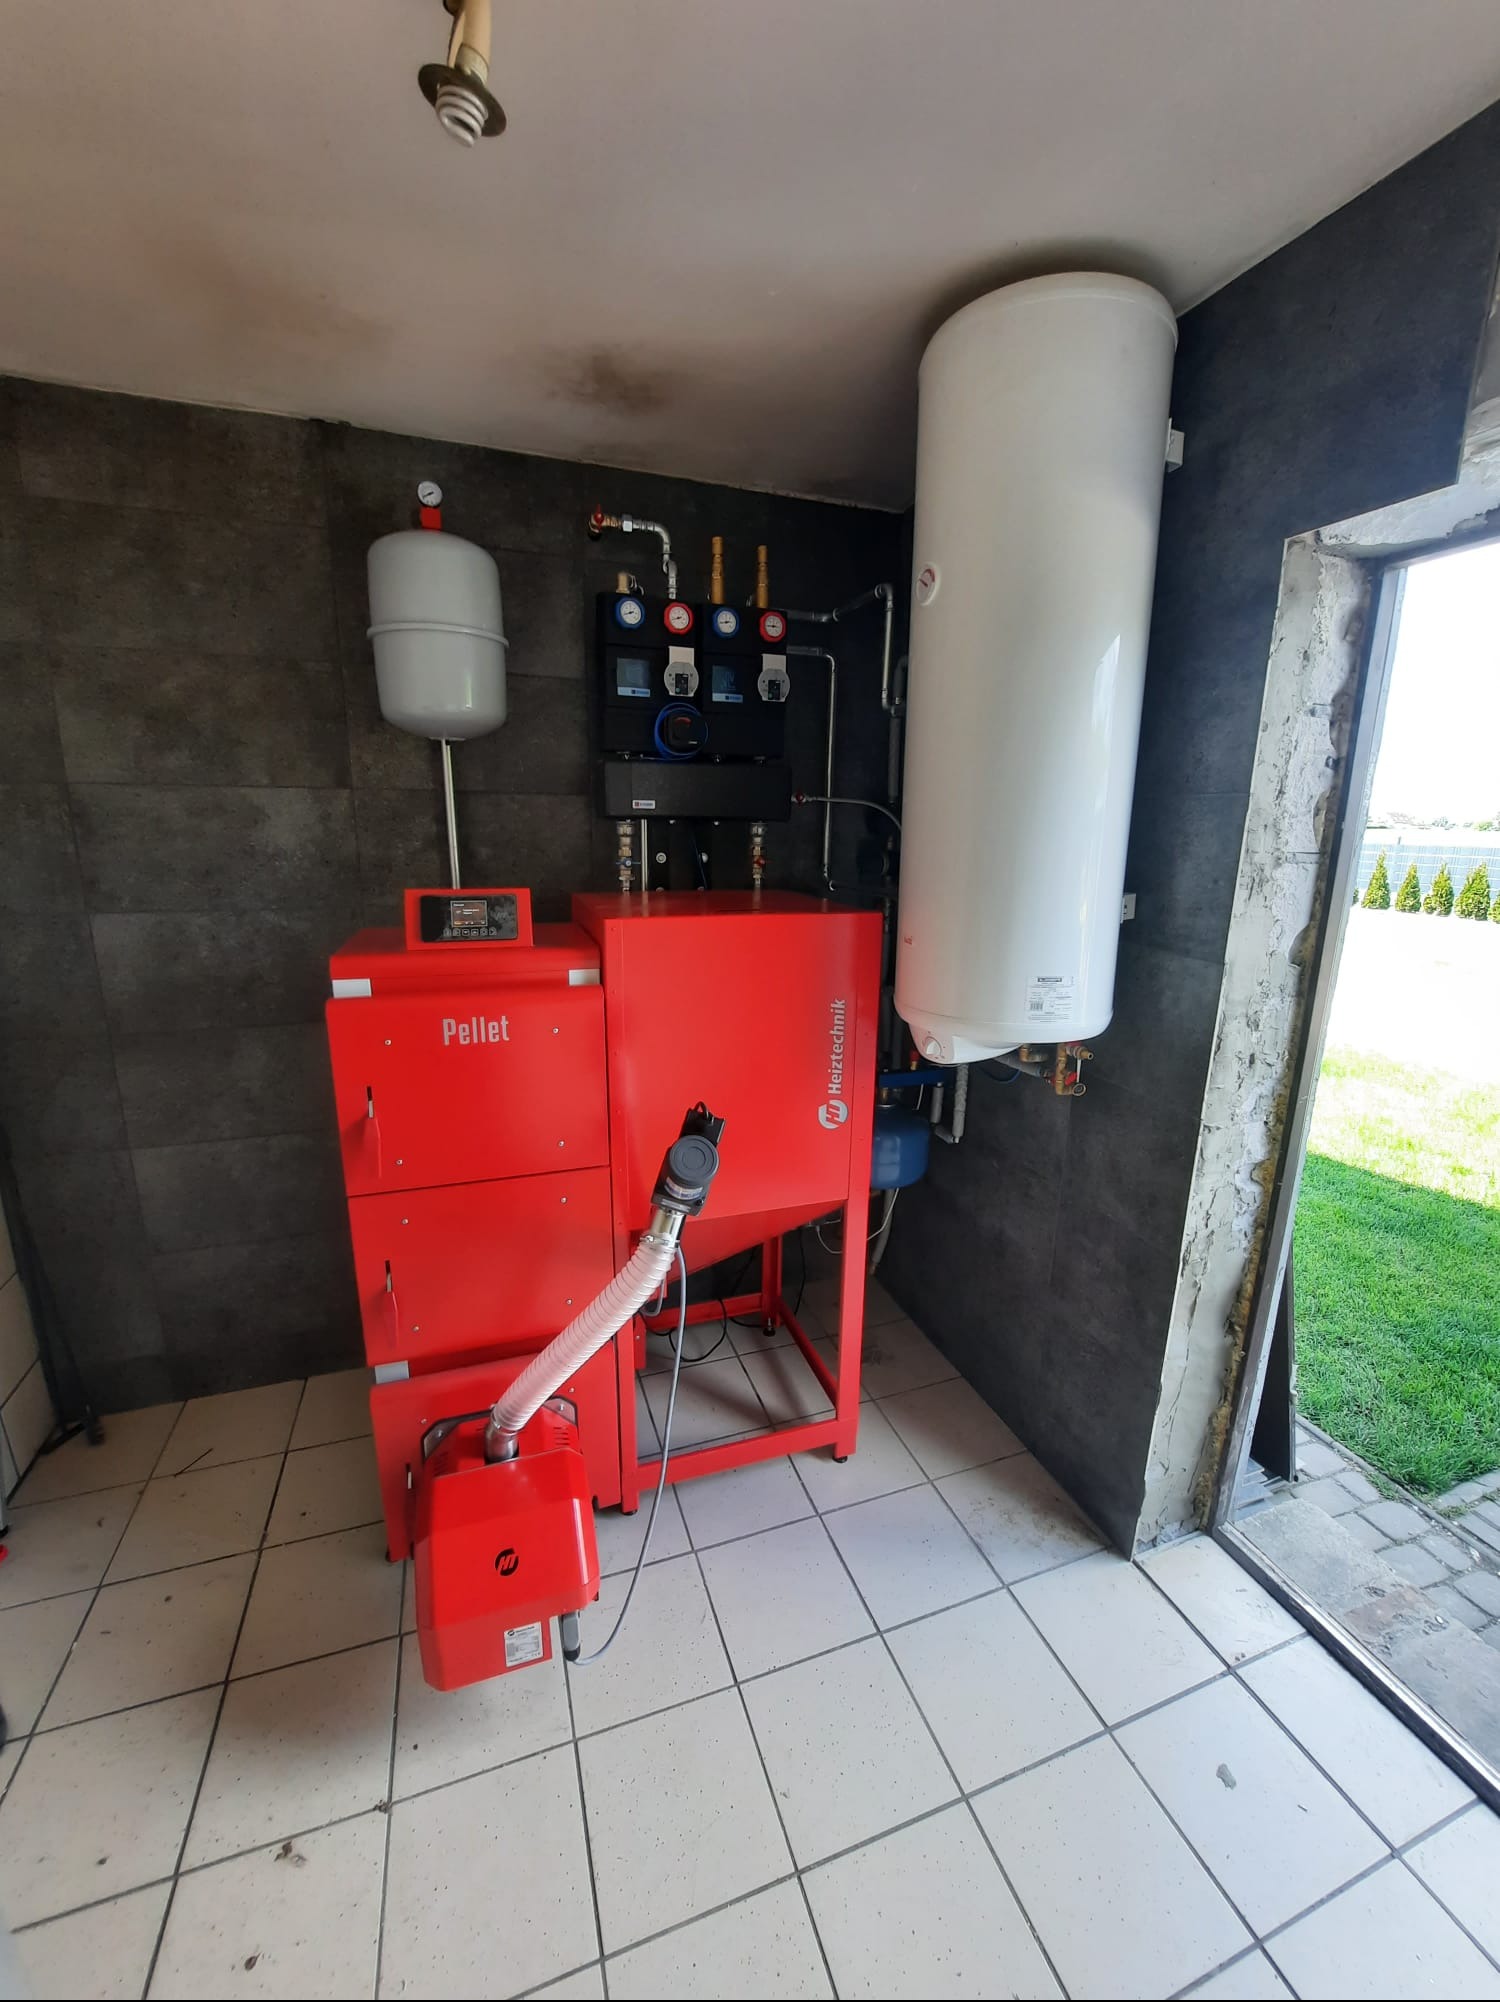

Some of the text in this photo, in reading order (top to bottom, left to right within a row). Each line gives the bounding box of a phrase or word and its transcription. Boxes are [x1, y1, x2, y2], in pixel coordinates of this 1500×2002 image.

[442, 1015, 510, 1046] Pellet
[828, 998, 846, 1095] Heiztechnik
[496, 1550, 518, 1574] HT
